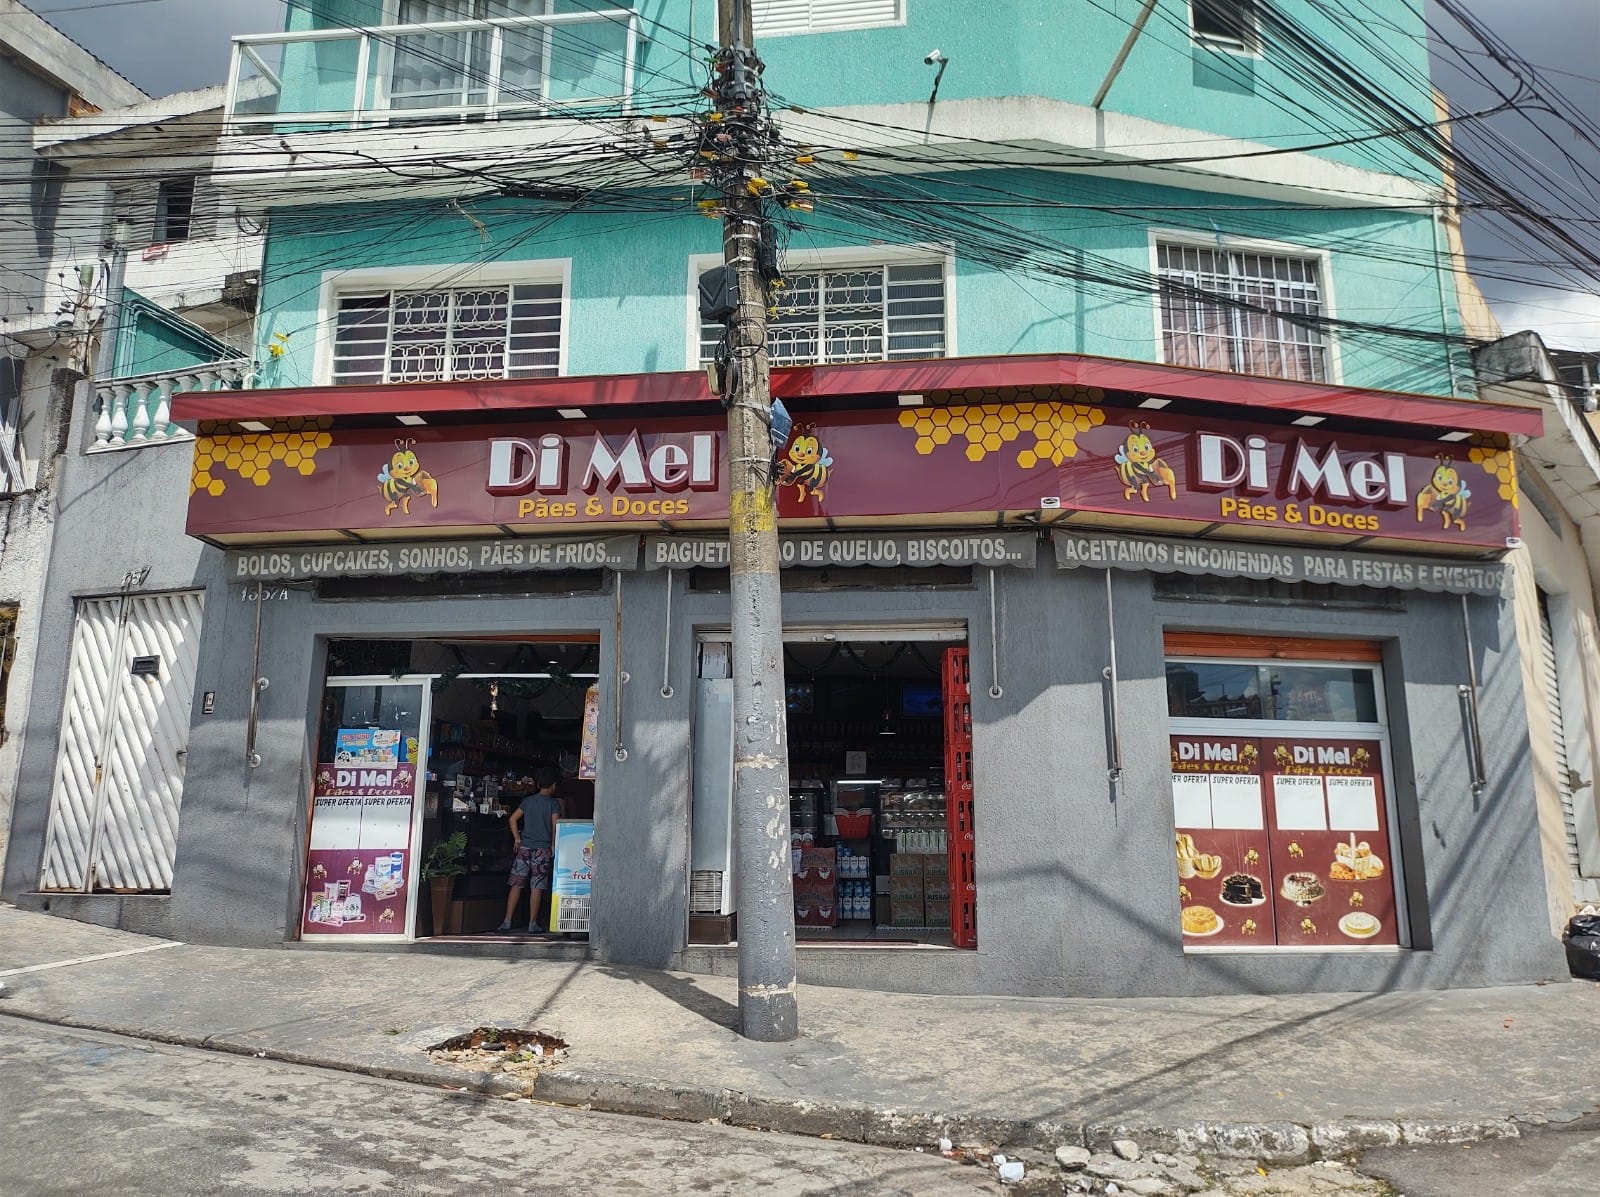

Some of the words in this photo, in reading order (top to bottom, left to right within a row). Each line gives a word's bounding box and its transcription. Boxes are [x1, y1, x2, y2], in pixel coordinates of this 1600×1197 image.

[487, 434, 566, 492] Di
[581, 430, 716, 493] Mel
[1199, 432, 1269, 491] Di
[1289, 438, 1409, 504] Mel
[518, 497, 577, 519] Pães
[584, 496, 604, 517] &
[611, 495, 690, 517] Doces
[1220, 497, 1278, 522] Pães
[1284, 503, 1303, 524] &
[1308, 505, 1380, 531] Doces
[236, 554, 296, 577] BOLOS,
[300, 549, 394, 574] CUPCAKES,
[399, 546, 473, 570] SONHOS,
[480, 541, 525, 566] PÃES
[529, 543, 552, 564] DE
[555, 542, 622, 564] FRIOS...
[656, 541, 731, 563] BAGUET
[800, 540, 824, 561] DE
[829, 539, 901, 565] QUEIJO,
[907, 538, 1022, 561] BISCOITOS...
[1065, 539, 1169, 564] ACEITAMOS
[1173, 545, 1294, 576] ENCOMENDAS
[1303, 555, 1348, 579] PARA
[1352, 559, 1414, 584] FESTAS
[1418, 565, 1430, 585] E
[1432, 566, 1506, 590] EVENTOS
[1178, 741, 1200, 760] Di
[1203, 742, 1238, 762] Mel
[1293, 745, 1315, 764] Di
[1317, 746, 1351, 765] Mel
[336, 770, 357, 787] Di
[360, 770, 393, 787] Mel
[1183, 775, 1207, 783] OFERTA
[1212, 776, 1233, 784] SUPER
[1234, 777, 1259, 785] OFERTA
[1276, 777, 1297, 786] SUPER
[1298, 777, 1321, 786] OFERTA
[1328, 778, 1349, 786] SUPER
[1350, 779, 1372, 787] OFERTA
[315, 798, 336, 806] SUPER
[337, 798, 362, 806] OFERTA
[364, 797, 386, 806] SUPER
[386, 797, 411, 806] OFERTA
[572, 870, 593, 880] frut
